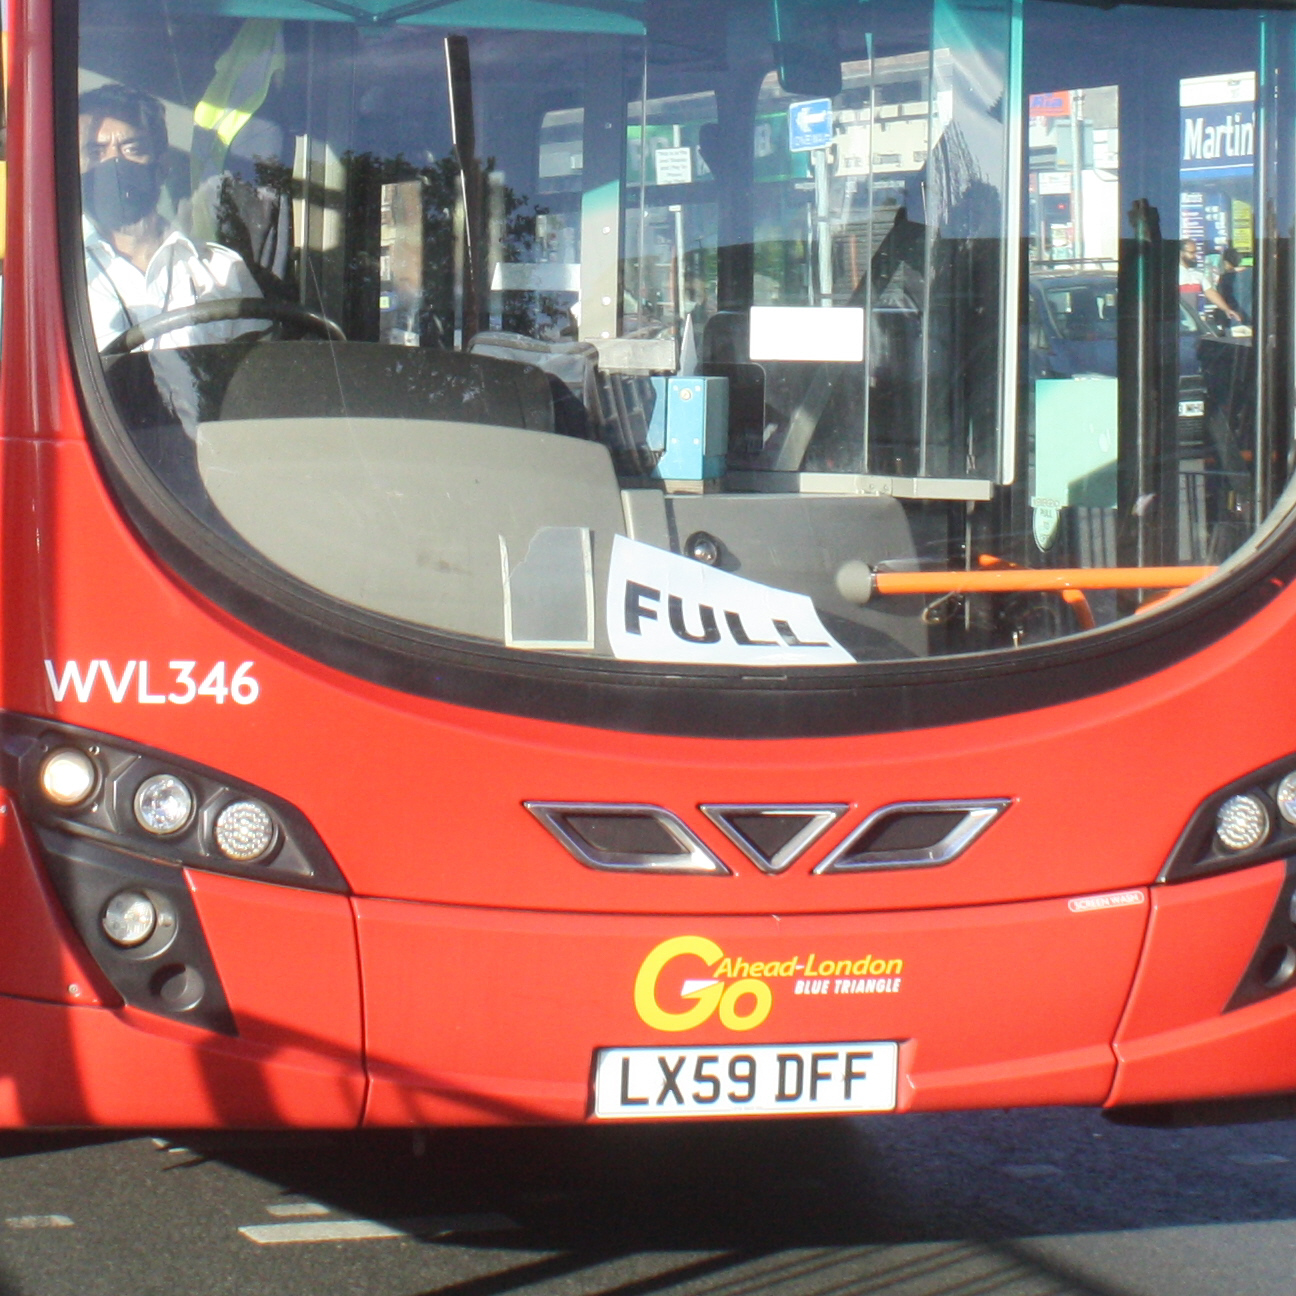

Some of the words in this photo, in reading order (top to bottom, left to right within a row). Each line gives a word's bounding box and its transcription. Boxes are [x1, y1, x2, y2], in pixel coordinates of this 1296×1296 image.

[1182, 111, 1256, 161] Martin'
[624, 579, 832, 648] FULL
[43, 659, 260, 705] WVL346
[633, 934, 773, 1032] Go
[713, 953, 903, 979] Ahead-London
[794, 979, 829, 995] BLUE
[834, 977, 902, 994] TRIANGLE
[620, 1054, 757, 1107] LX59
[774, 1051, 874, 1103] DFF
